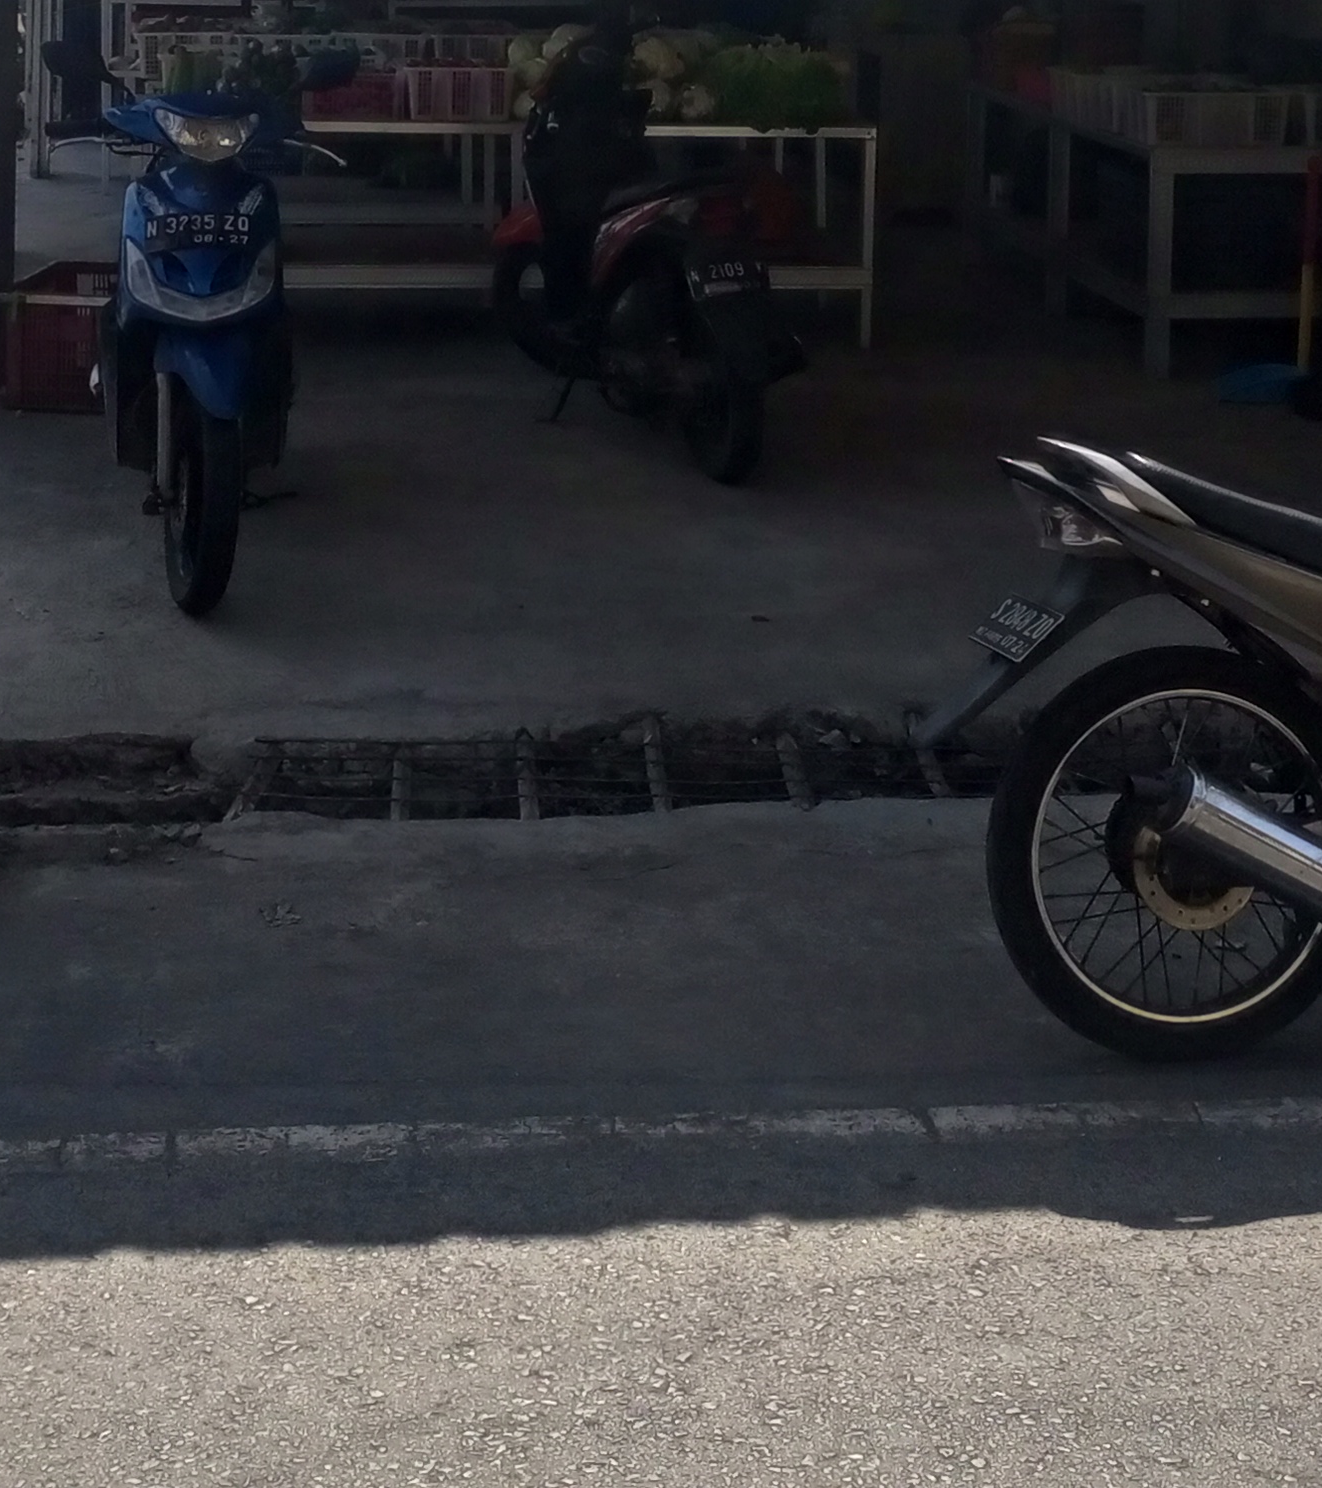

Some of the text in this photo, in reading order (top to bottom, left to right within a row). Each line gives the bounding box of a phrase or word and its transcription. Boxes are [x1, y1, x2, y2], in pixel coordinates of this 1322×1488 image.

[147, 220, 157, 238] N
[709, 261, 745, 278] 2109
[990, 598, 1013, 619] S
